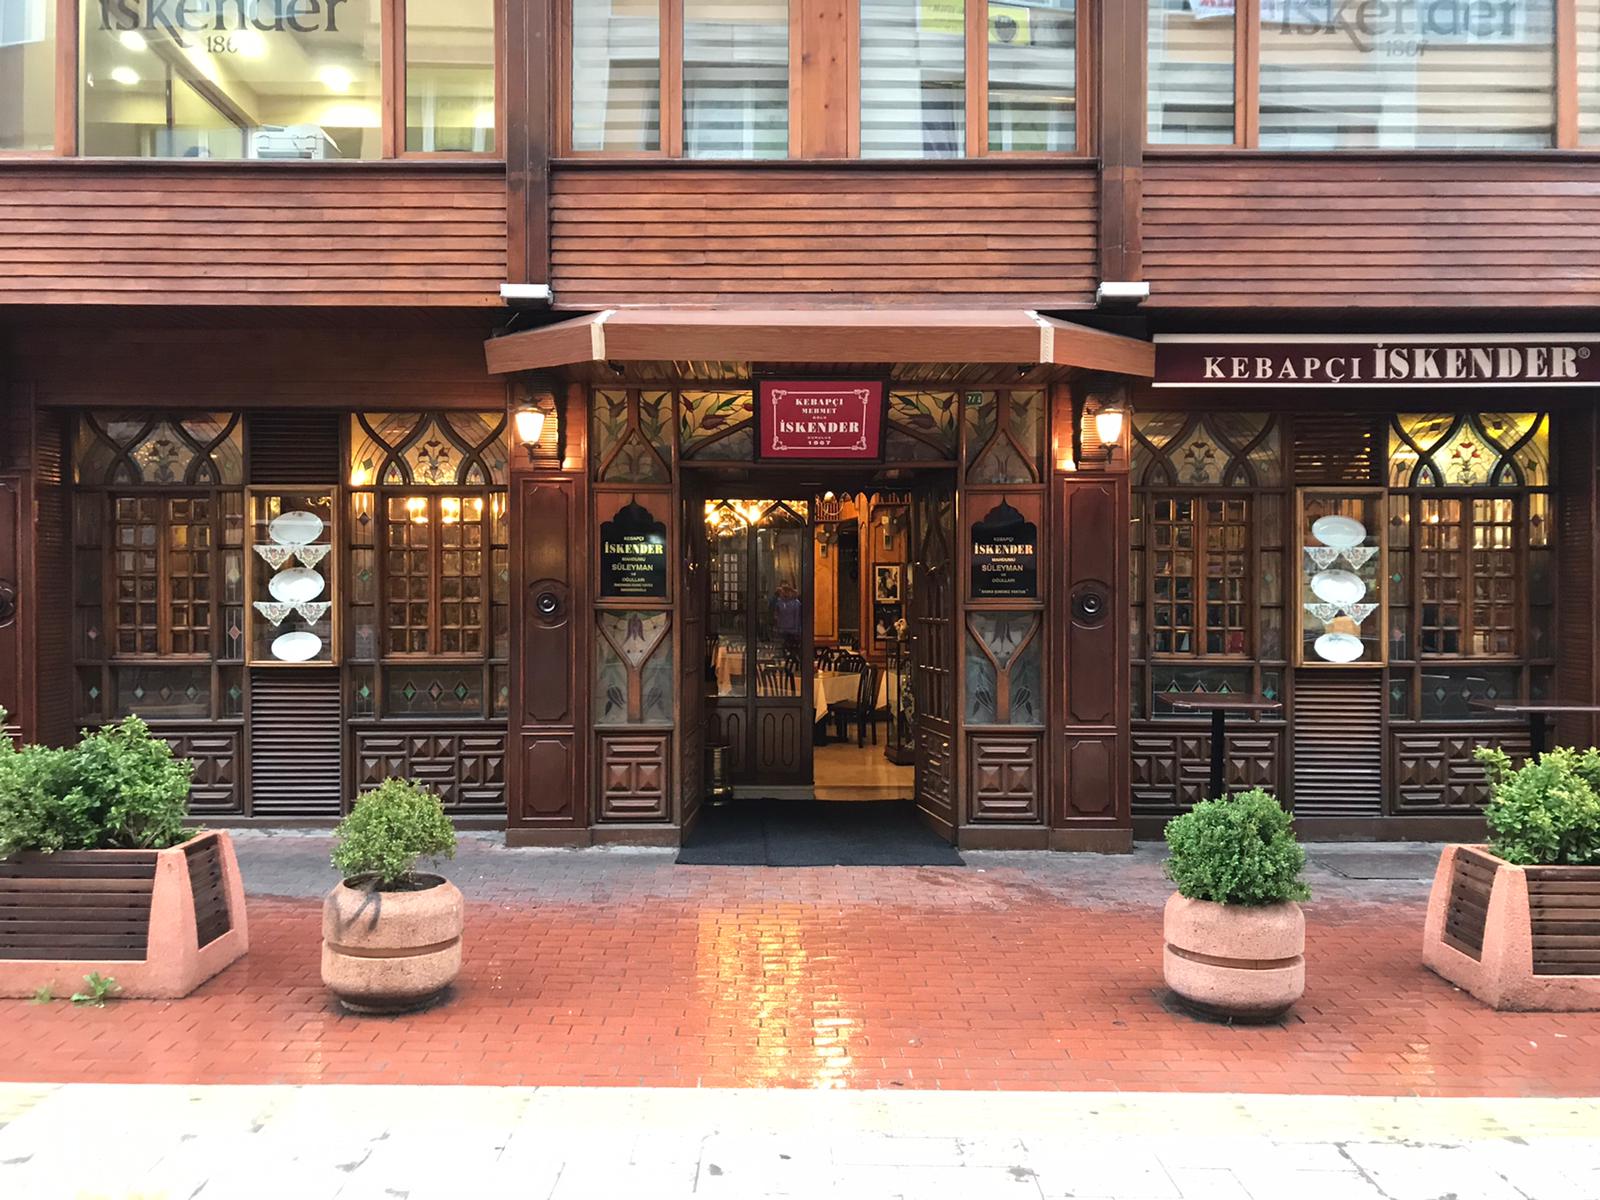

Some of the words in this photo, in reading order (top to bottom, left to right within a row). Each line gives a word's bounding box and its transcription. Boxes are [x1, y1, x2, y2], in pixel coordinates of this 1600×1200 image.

[206, 35, 239, 54] 186
[1203, 356, 1362, 383] KEBAPÇI
[795, 398, 844, 407] KEBAPÇI
[780, 419, 860, 433] İSKENDER
[604, 542, 663, 554] İSKENDER
[974, 542, 1033, 554] İSKENDER
[611, 563, 654, 571] SÜLEYMAN
[981, 563, 1024, 572] SÜLEYMAN
